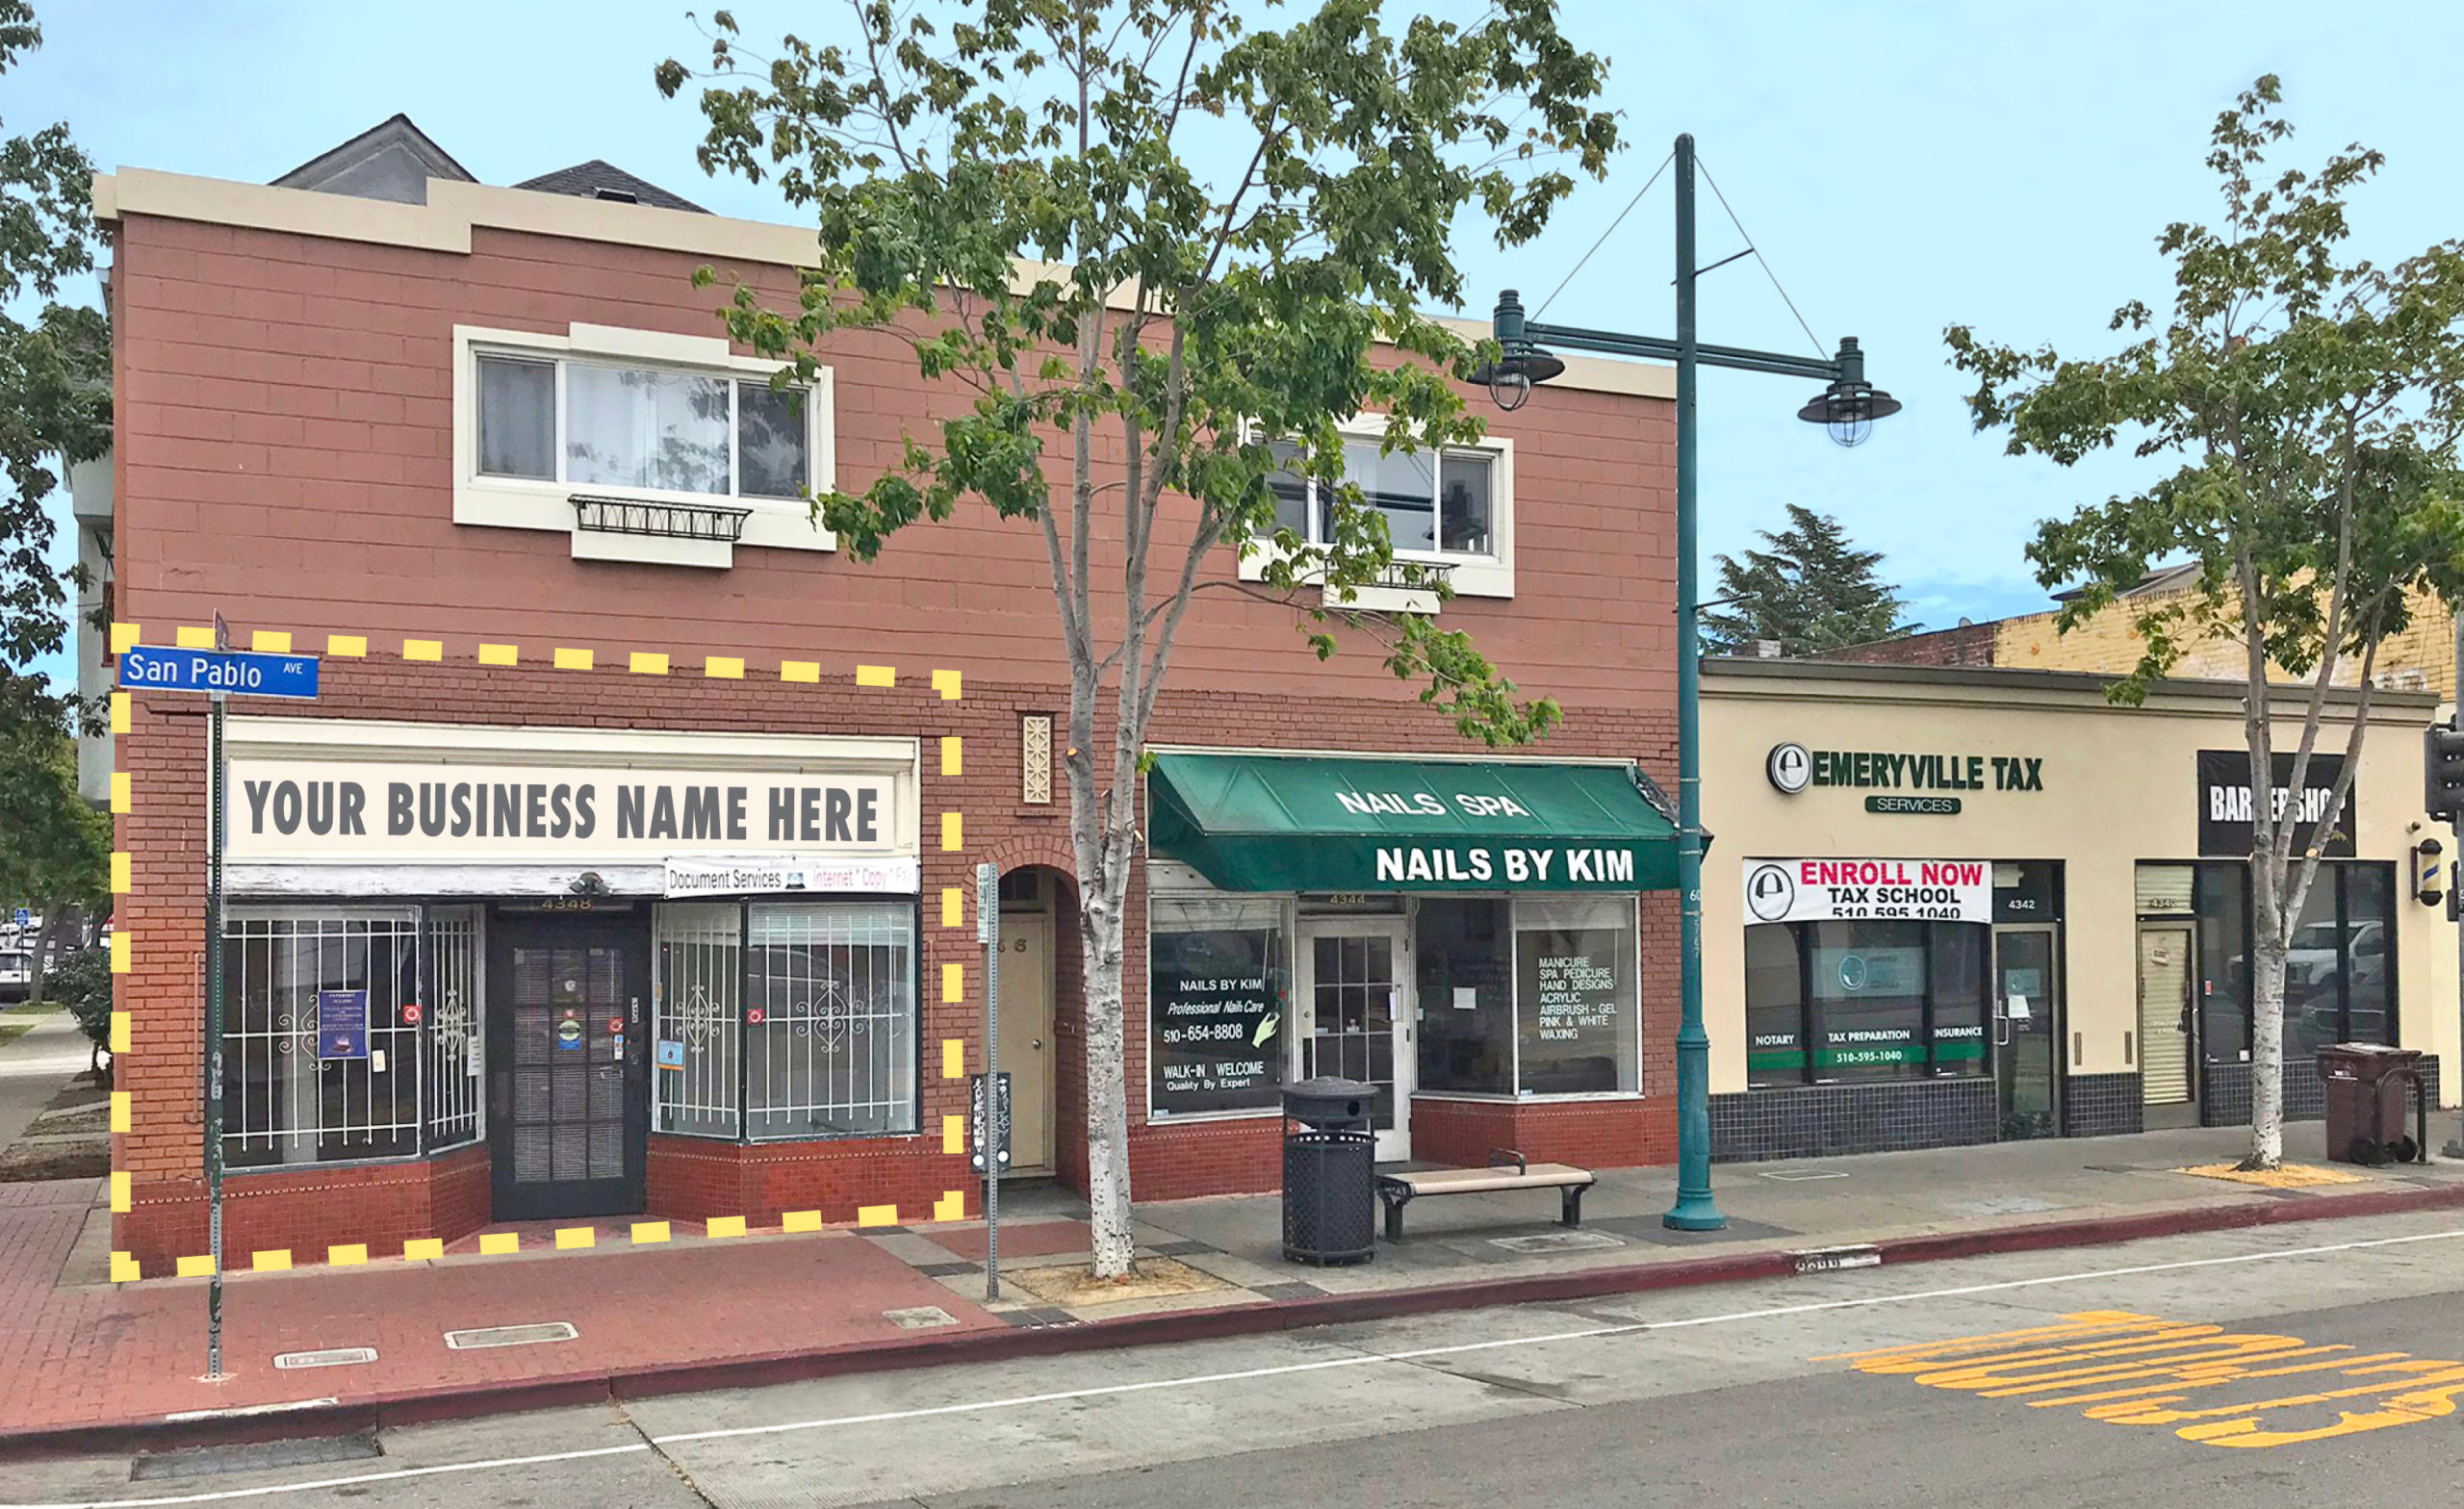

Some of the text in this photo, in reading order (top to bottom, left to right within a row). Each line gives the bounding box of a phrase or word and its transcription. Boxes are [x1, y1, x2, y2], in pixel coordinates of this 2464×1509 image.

[126, 653, 303, 689] San Pablo AVE
[1812, 751, 1985, 791] EMERYVILLE
[1991, 756, 2043, 792] TAX
[1335, 791, 1530, 818] NAILS SPA
[1876, 797, 1953, 813] SERVICES
[1376, 847, 1634, 883] NAILS BY KIM
[670, 869, 730, 889] Document
[733, 868, 782, 888] Services
[812, 868, 854, 886] Internet
[861, 868, 887, 889] Copy
[1801, 862, 1984, 886] ENROLL NOW
[1330, 894, 1365, 905] 4344
[1828, 887, 1961, 904] TAX SCHOOL
[542, 898, 592, 910] 4348
[2009, 900, 2036, 909] 4342
[1539, 957, 1589, 968] MANICURE
[1539, 968, 1611, 980] SPA PEDICURE
[1180, 979, 1263, 991] NAILS BY KIM
[1539, 979, 1614, 991] HAND DESIGNS
[1540, 992, 1581, 1004] ACRYLIC
[1168, 1001, 1221, 1016] Professional
[1244, 999, 1265, 1013] Care
[1540, 1004, 1589, 1015] AIRBRUSH
[1599, 1003, 1617, 1014] GEL
[1539, 1015, 1609, 1028] PINK & WHITE
[1163, 1023, 1244, 1043] 510-654-8808
[1539, 1028, 1578, 1040] WAXING
[1828, 1030, 1911, 1043] TAX PREPARATION
[1755, 1034, 1795, 1046] NOTARY
[1835, 1050, 1903, 1063] 510-595-1040
[1163, 1061, 1265, 1079] WALK-IN WELCOME
[1167, 1078, 1250, 1093] Quality By Expert
